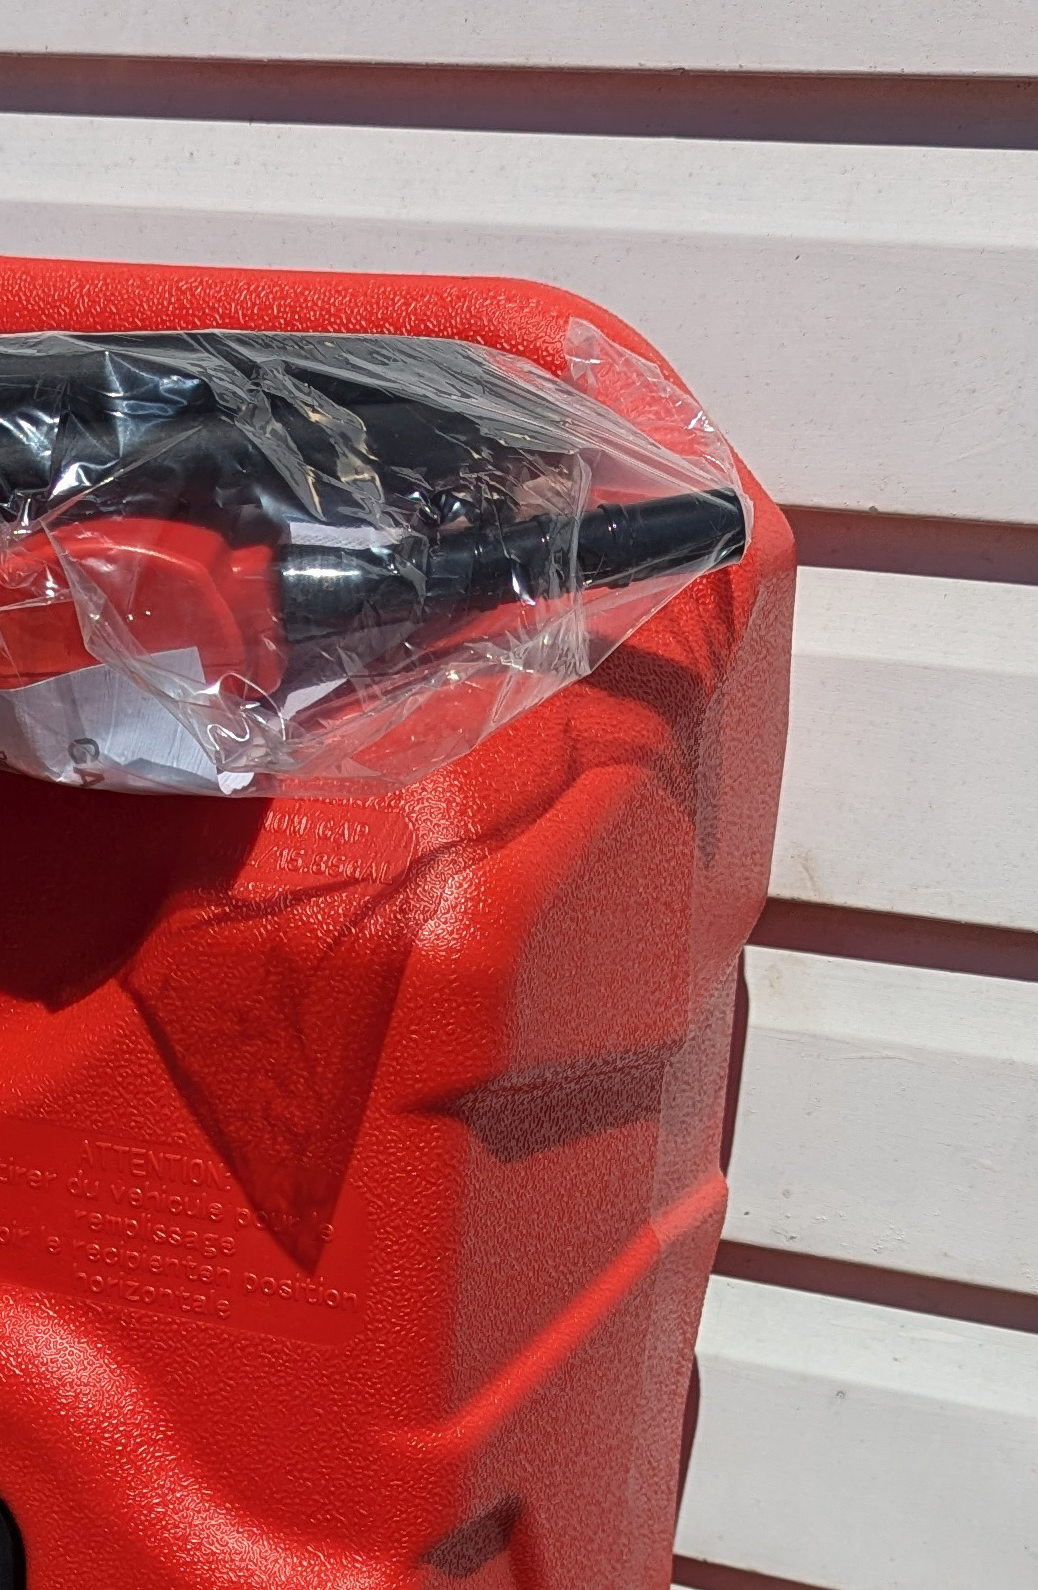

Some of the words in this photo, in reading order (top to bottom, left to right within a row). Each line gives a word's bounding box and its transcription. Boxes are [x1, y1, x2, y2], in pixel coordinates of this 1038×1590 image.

[67, 1169, 100, 1197] du
[80, 1139, 232, 1191] ATTENTION:
[74, 1209, 237, 1260] remplissage
[72, 1262, 232, 1320] horizontale
[243, 1272, 359, 1314] position
